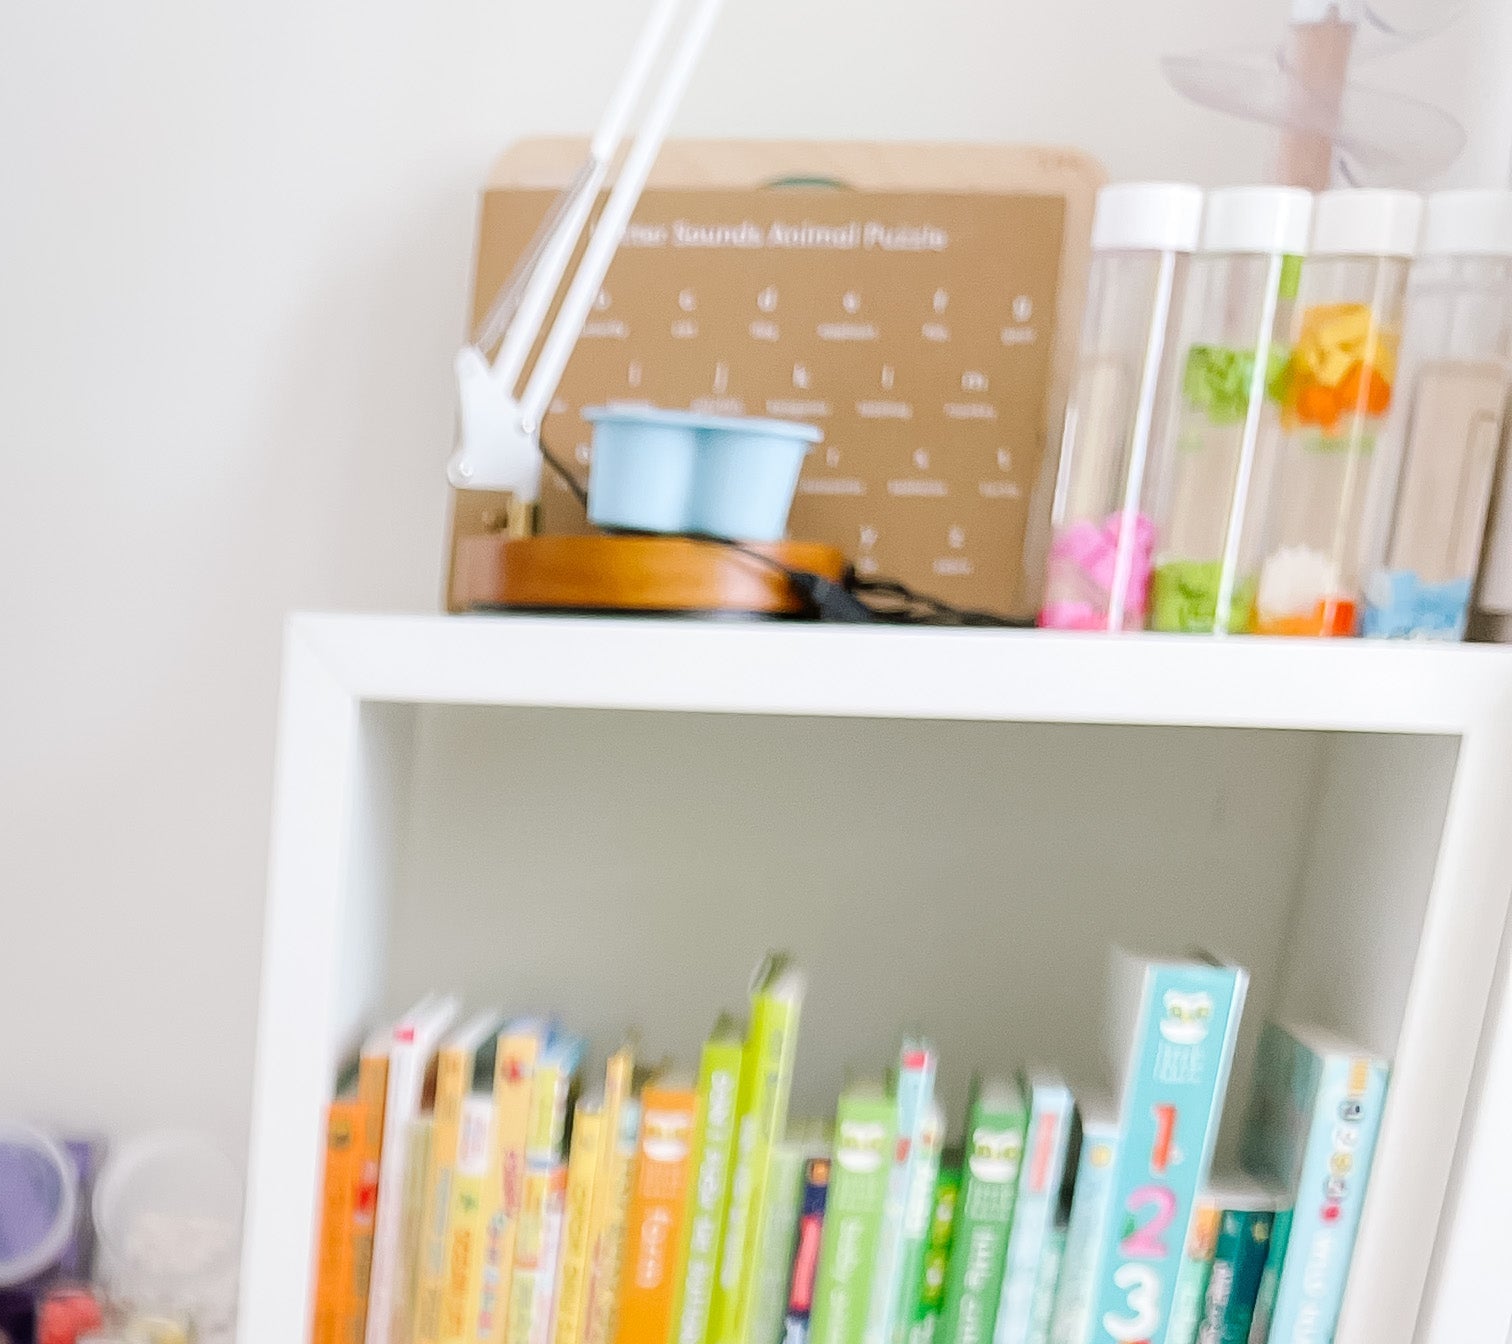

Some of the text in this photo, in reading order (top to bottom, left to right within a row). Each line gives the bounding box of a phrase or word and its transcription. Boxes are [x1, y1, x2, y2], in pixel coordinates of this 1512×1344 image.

[767, 221, 859, 249] Animal
[1150, 1103, 1177, 1175] 1
[1120, 1184, 1177, 1258] 2
[1102, 1262, 1161, 1342] 3
